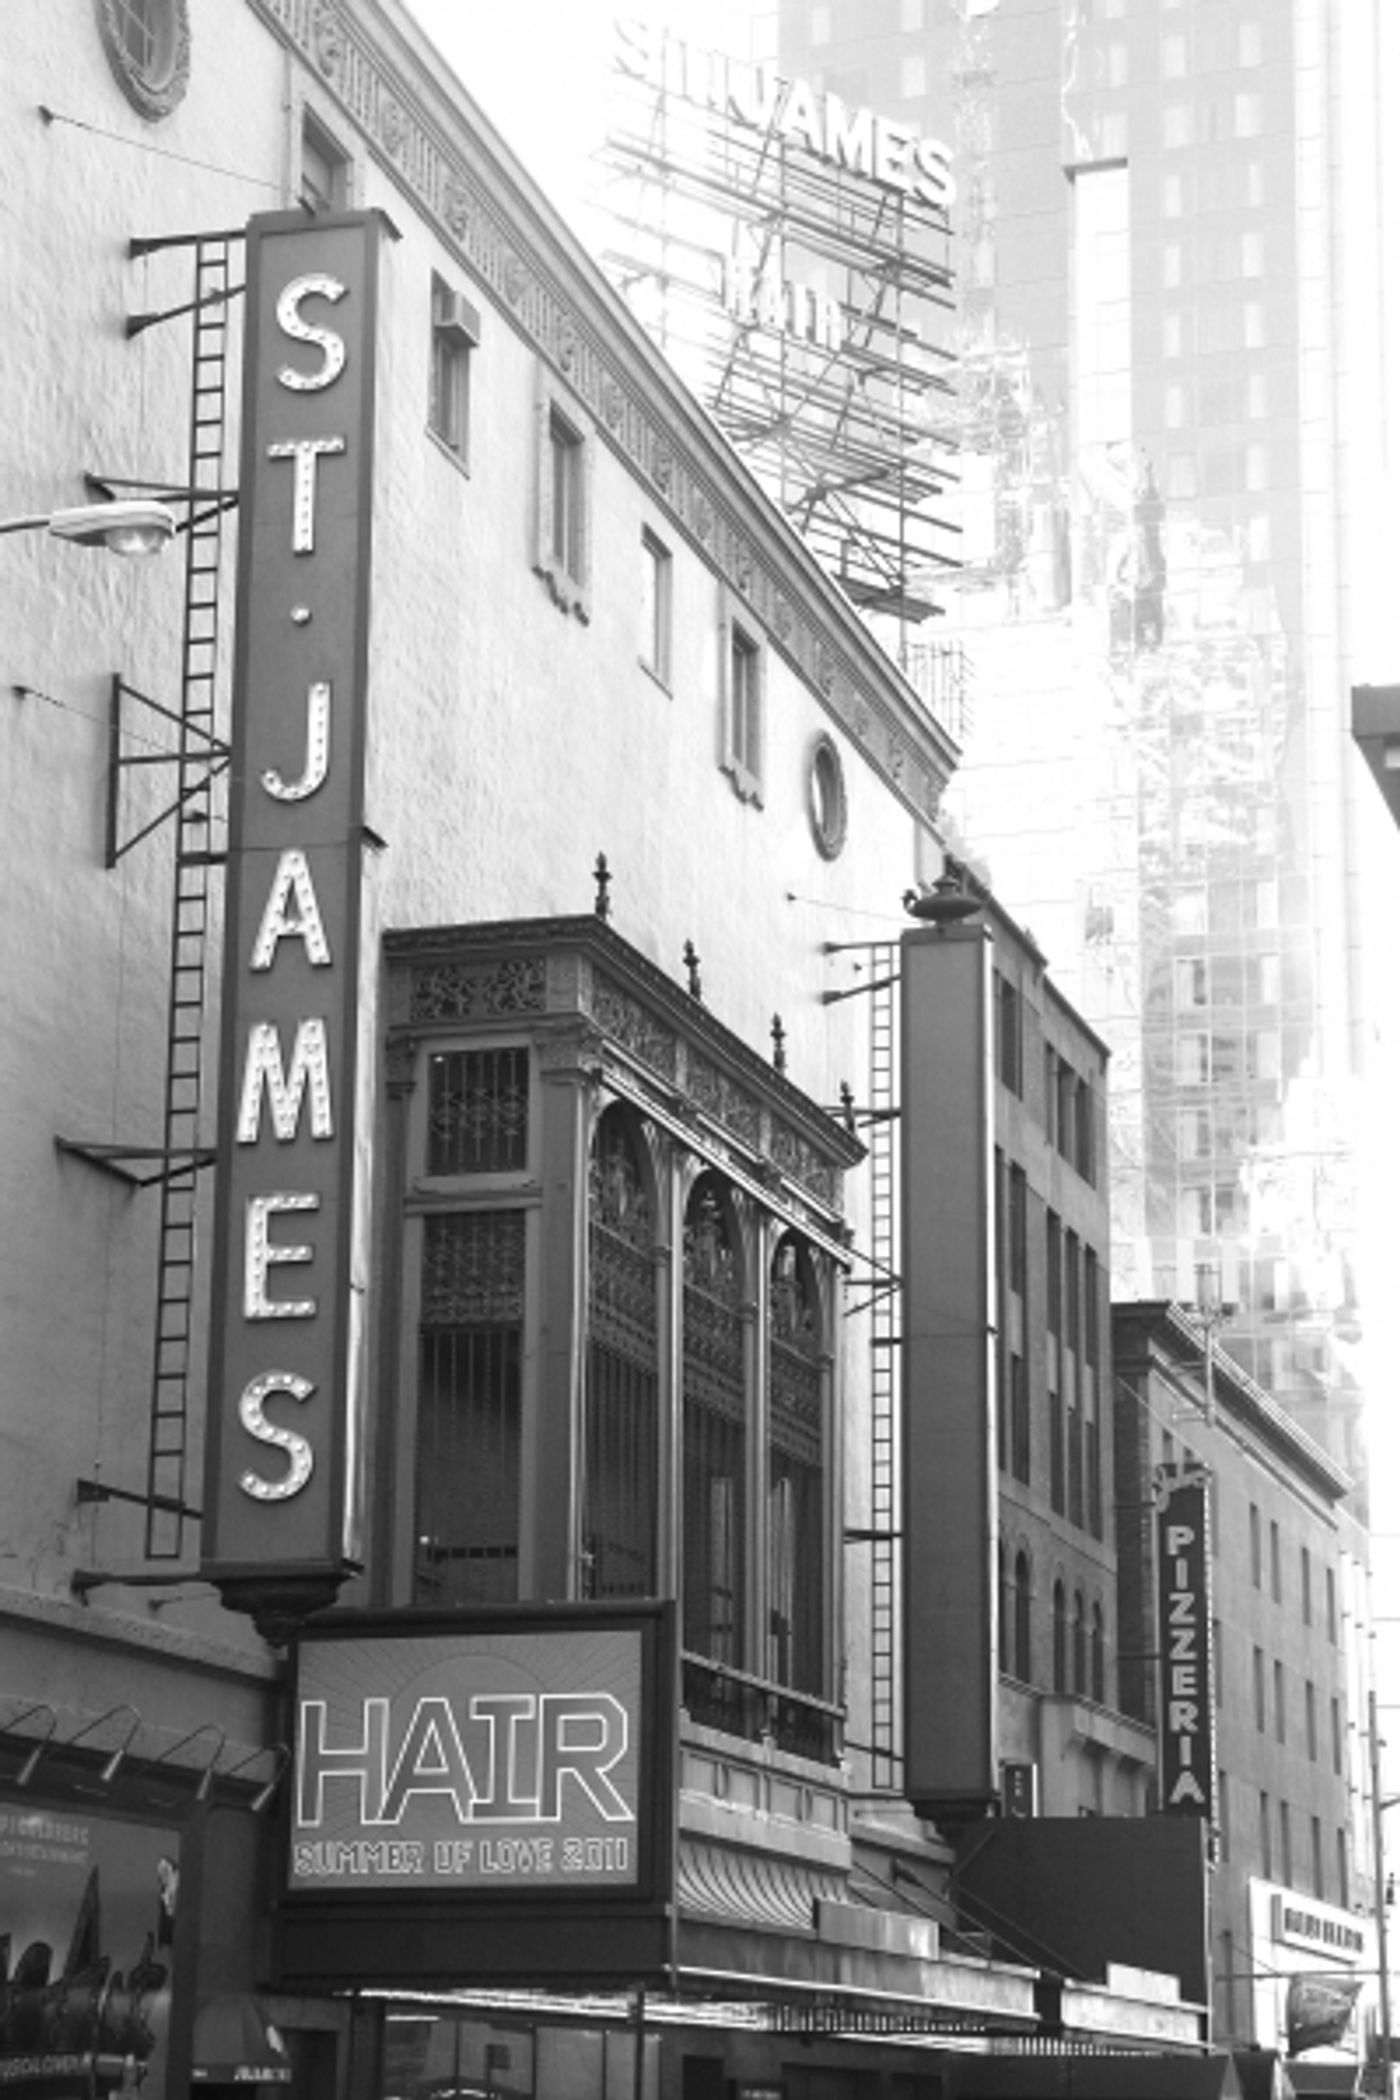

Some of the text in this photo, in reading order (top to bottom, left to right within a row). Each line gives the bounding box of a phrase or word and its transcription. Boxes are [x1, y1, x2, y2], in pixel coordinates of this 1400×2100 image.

[726, 58, 958, 208] JAMES
[236, 681, 333, 1501] JAMES
[1166, 1525, 1205, 1803] PIZZERIA
[297, 1692, 635, 1827] HAIR
[293, 1837, 628, 1876] SUMMER OF LOVE 2011
